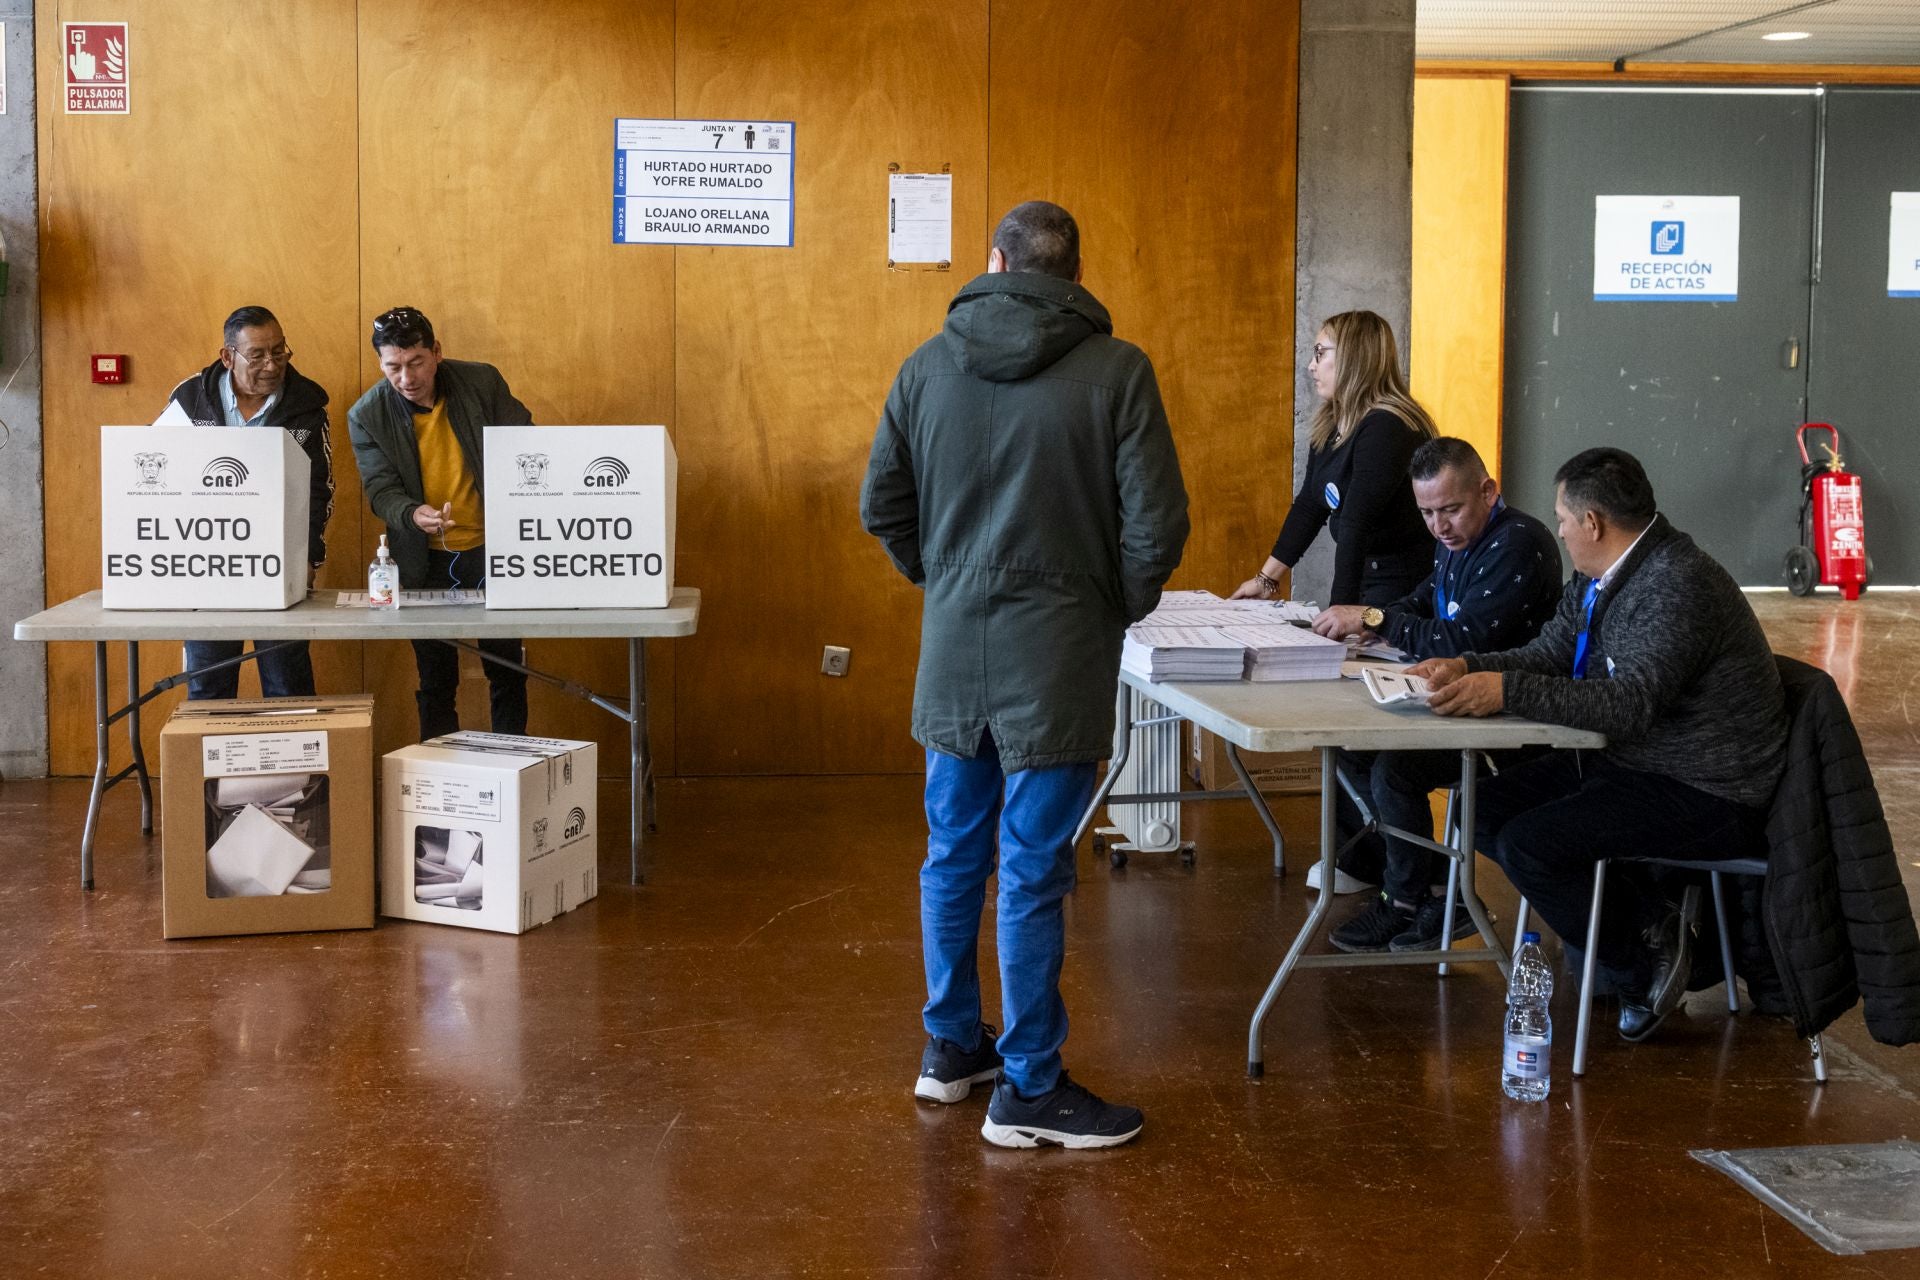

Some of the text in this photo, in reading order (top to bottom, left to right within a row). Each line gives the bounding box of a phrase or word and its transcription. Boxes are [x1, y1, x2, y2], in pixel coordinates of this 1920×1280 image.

[70, 88, 124, 98] PULSADOR
[70, 99, 124, 109] DE ALARMA
[712, 133, 724, 149] 7
[644, 161, 772, 174] HURTADO HURTADO
[653, 175, 763, 188] YOFRE RUMALDO
[645, 207, 770, 220] LOJANO ORELLANA
[644, 222, 770, 235] BRAULIO ARMANDO
[1621, 259, 1712, 275] RECEPCIÓN
[1630, 277, 1705, 290] DE ACTAS
[137, 517, 251, 541] EL VOTO
[519, 517, 632, 541] EL VOTO
[107, 554, 281, 577] ES SECRETO
[490, 553, 662, 578] ES SECRETO
